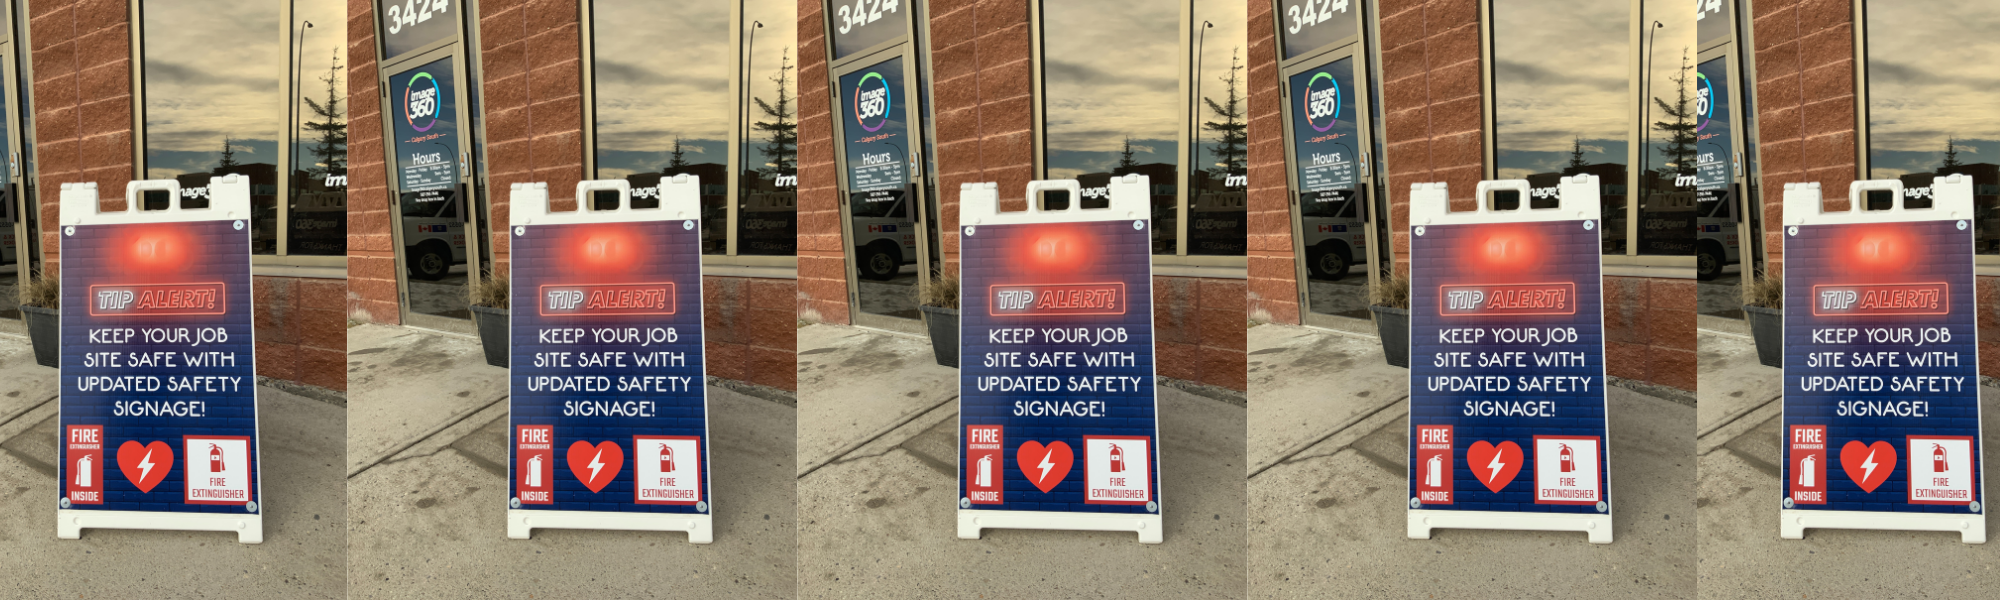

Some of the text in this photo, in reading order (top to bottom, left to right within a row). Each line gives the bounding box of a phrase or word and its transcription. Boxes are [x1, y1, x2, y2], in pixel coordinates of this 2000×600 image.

[388, 0, 449, 34] 3424
[838, 0, 899, 34] 3424
[1288, 0, 1349, 34] 3424
[410, 87, 436, 102] image
[860, 87, 886, 102] image
[1310, 87, 1336, 102] image
[410, 97, 434, 119] 360
[860, 97, 884, 119] 360
[1310, 97, 1334, 119] 360
[412, 152, 440, 165] Hours
[862, 152, 890, 165] Hours
[1312, 152, 1340, 165] Hours
[98, 288, 216, 310] TIP ALERT!
[548, 288, 666, 310] TIP ALERT!
[998, 288, 1116, 310] TIP ALERT!
[1448, 288, 1566, 310] TIP ALERT!
[1821, 288, 1940, 310] TIP ALERT!
[88, 328, 228, 346] KEEP YOUR JOB
[538, 328, 678, 346] KEEP YOUR JOB
[988, 328, 1128, 346] KEEP YOUR JOB
[1438, 328, 1578, 346] KEEP YOUR JOB
[1812, 328, 1950, 346] KEEP YOUR JOB
[84, 352, 234, 368] SITE SAFE WITH
[534, 352, 684, 368] SITE SAFE WITH
[984, 352, 1134, 368] SITE SAFE WITH
[1434, 352, 1584, 368] SITE SAFE WITH
[1806, 352, 1958, 368] SITE SAFE WITH
[78, 376, 242, 392] UPDATED SAFETY
[528, 376, 692, 392] UPDATED SAFETY
[978, 376, 1142, 392] UPDATED SAFETY
[1428, 376, 1592, 392] UPDATED SAFETY
[1800, 376, 1964, 392] UPDATED SAFETY
[114, 401, 206, 417] SIGNAGE!
[564, 401, 656, 417] SIGNAGE!
[1014, 401, 1106, 417] SIGNAGE!
[1464, 401, 1556, 417] SIGNAGE!
[1836, 401, 1928, 417] SIGNAGE!
[72, 429, 98, 443] FIRE
[522, 429, 548, 443] FIRE
[972, 429, 998, 443] FIRE
[1422, 429, 1448, 443] FIRE
[1794, 429, 1822, 443] FIRE
[210, 478, 226, 487] FIRE
[660, 478, 676, 487] FIRE
[1110, 478, 1126, 487] FIRE
[1560, 478, 1576, 487] FIRE
[1932, 478, 1948, 487] FIRE
[72, 490, 98, 502] INSIDE
[192, 489, 244, 499] EXTINGUISHER
[522, 490, 548, 502] INSIDE
[642, 489, 694, 499] EXTINGUISHER
[972, 490, 998, 502] INSIDE
[1092, 489, 1144, 499] EXTINGUISHER
[1422, 490, 1448, 502] INSIDE
[1542, 489, 1594, 499] EXTINGUISHER
[1794, 490, 1822, 502] INSIDE
[1916, 489, 1968, 499] EXTINGUISHER
